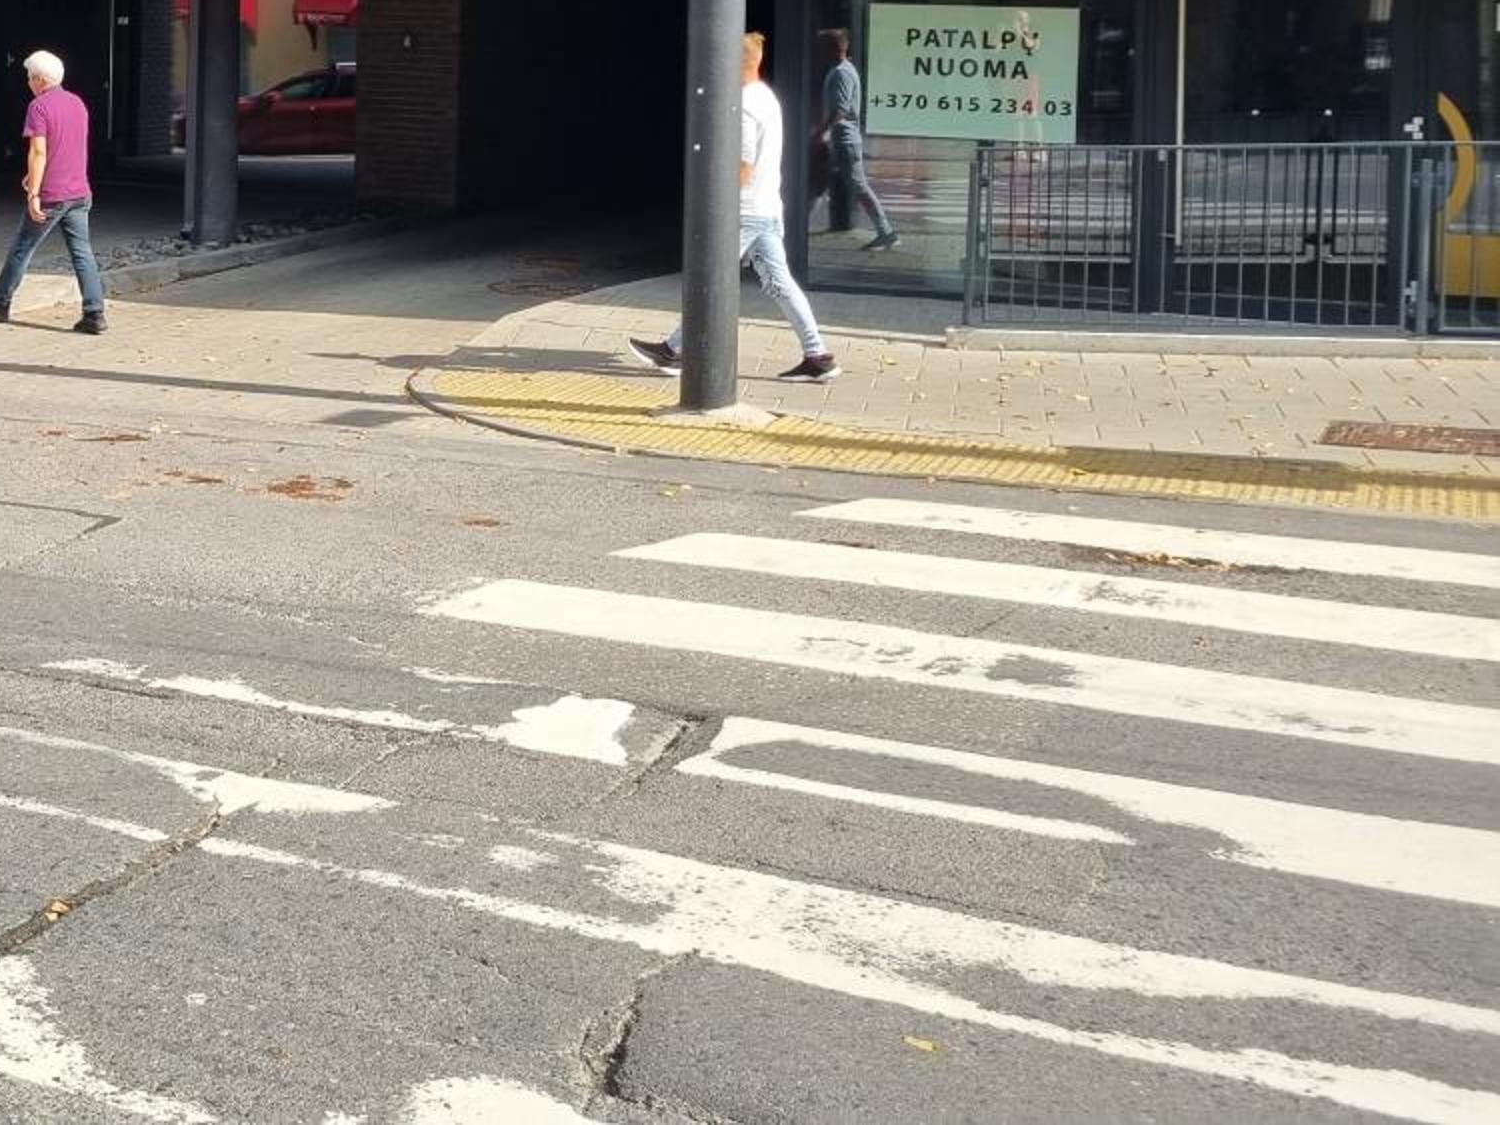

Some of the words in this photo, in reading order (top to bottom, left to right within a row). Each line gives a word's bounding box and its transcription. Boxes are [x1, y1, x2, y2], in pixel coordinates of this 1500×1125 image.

[914, 57, 1029, 80] NUOMA
[870, 93, 928, 110] +370
[937, 95, 980, 112] 615
[991, 97, 1034, 115] 234
[1044, 100, 1073, 116] 03
